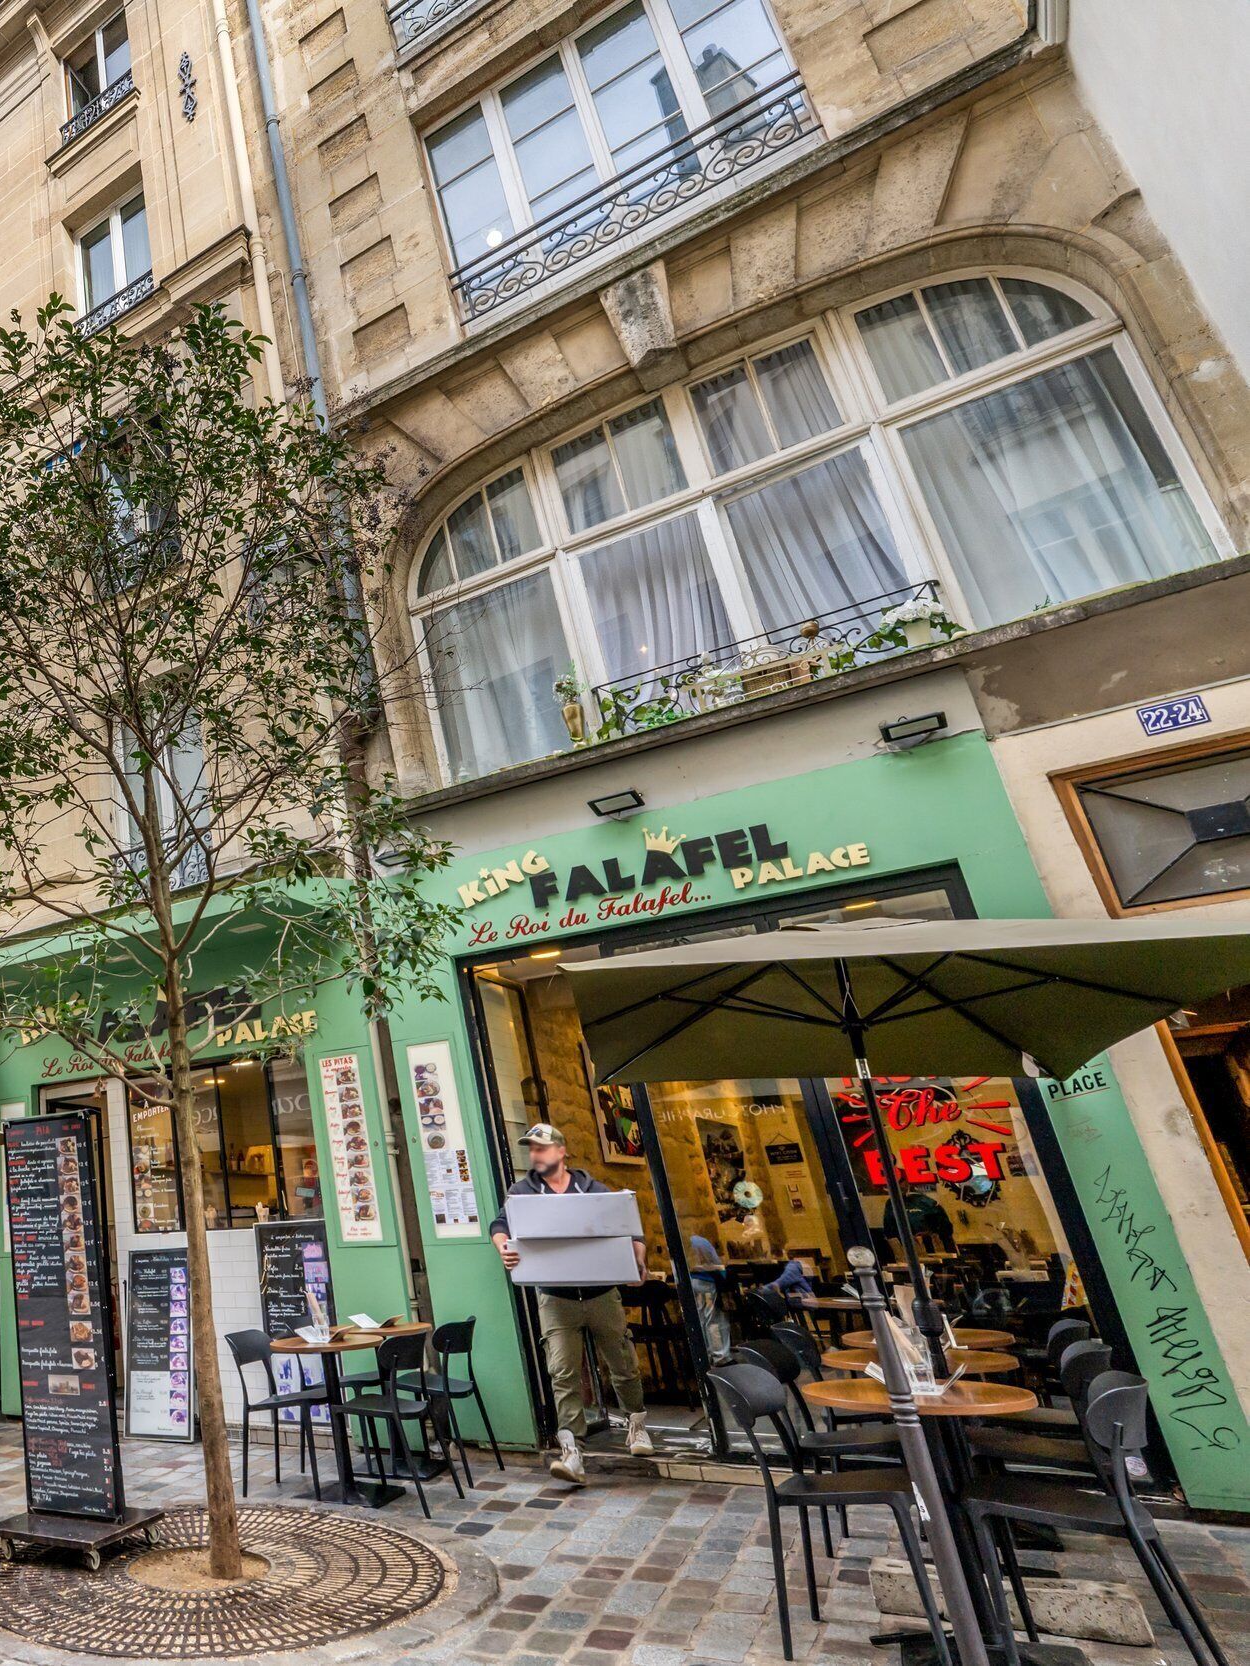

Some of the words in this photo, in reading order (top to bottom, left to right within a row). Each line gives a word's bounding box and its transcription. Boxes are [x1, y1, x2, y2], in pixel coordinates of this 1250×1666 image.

[1143, 701, 1203, 730] 22-24
[529, 823, 789, 908] FALAFEL
[730, 843, 871, 889] PALACE
[468, 920, 498, 948] Le
[505, 911, 551, 940] Roi
[559, 907, 589, 929] du
[334, 1057, 353, 1065] PITAS
[1048, 1072, 1106, 1099] PLACE
[878, 1088, 962, 1130] The
